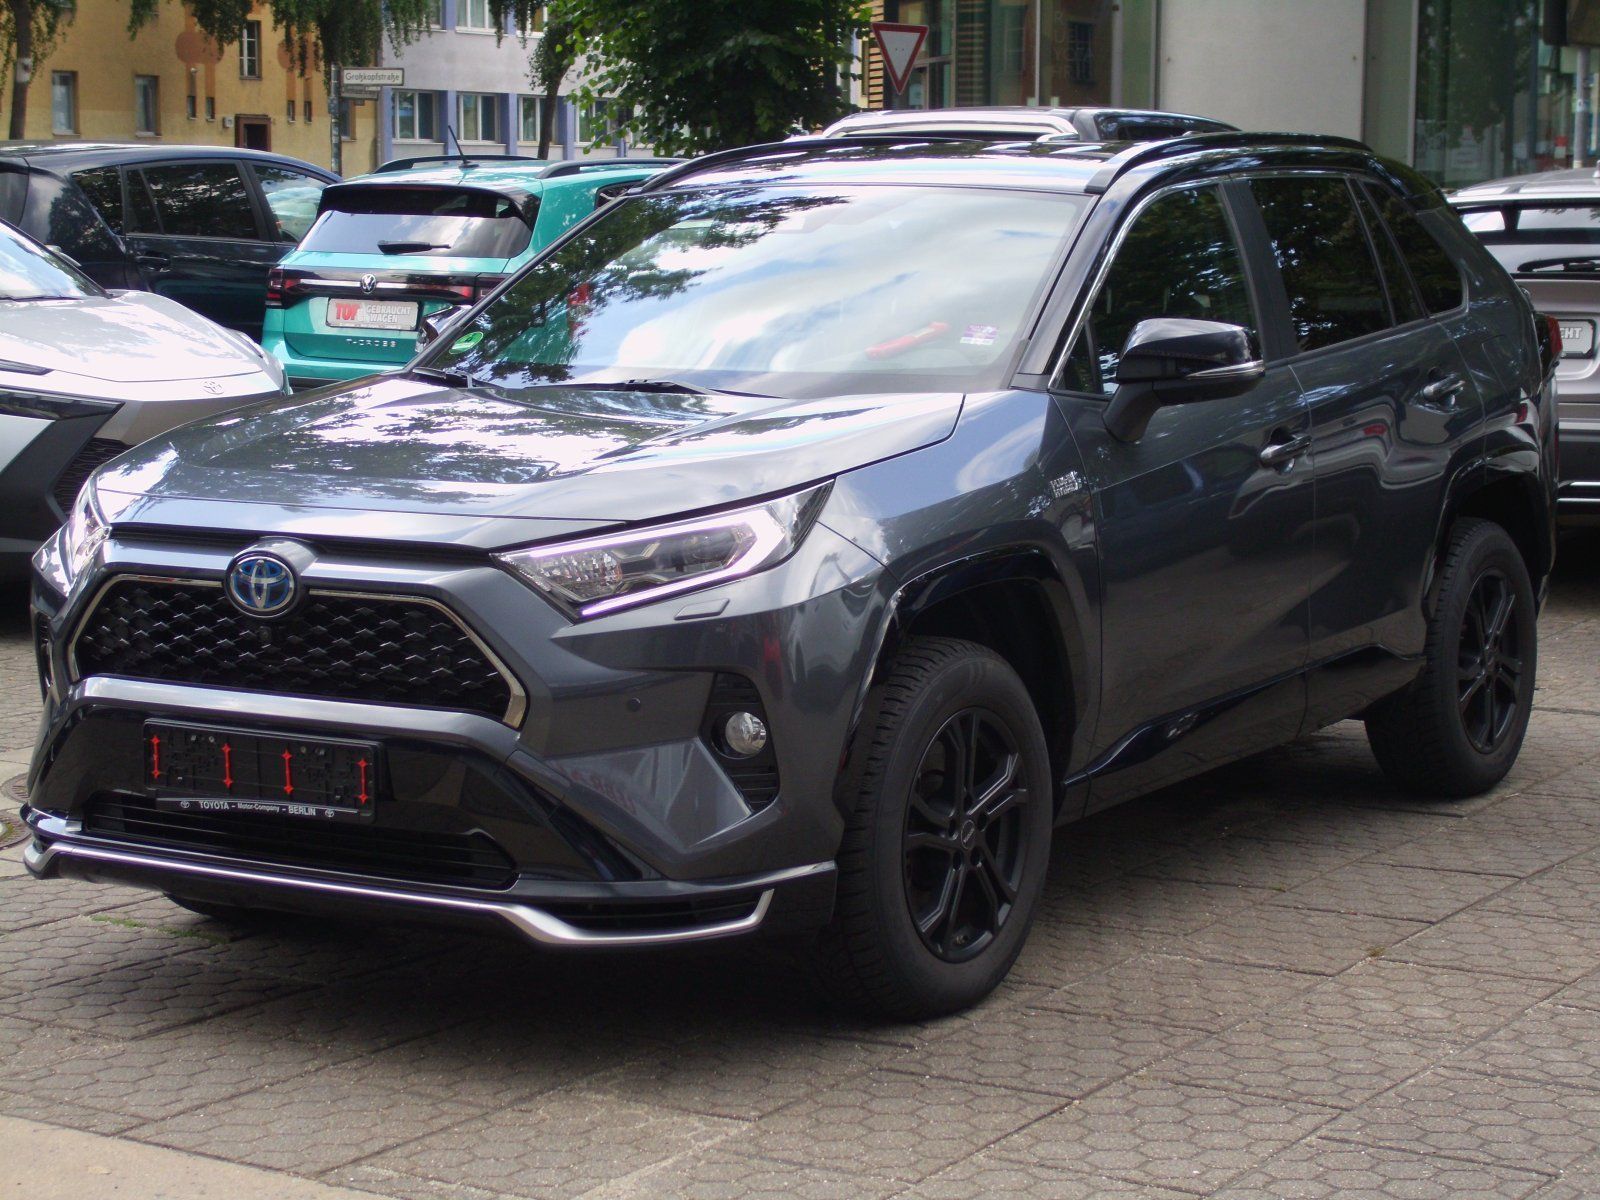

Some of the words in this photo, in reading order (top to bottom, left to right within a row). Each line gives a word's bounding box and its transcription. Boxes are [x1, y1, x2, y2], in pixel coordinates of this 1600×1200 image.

[345, 72, 400, 82] Großkopfstraße
[366, 304, 411, 315] GEBRAUCHT
[369, 313, 398, 323] WAGEN
[199, 800, 229, 810] TOYOTA
[288, 805, 316, 816] BERLIN
